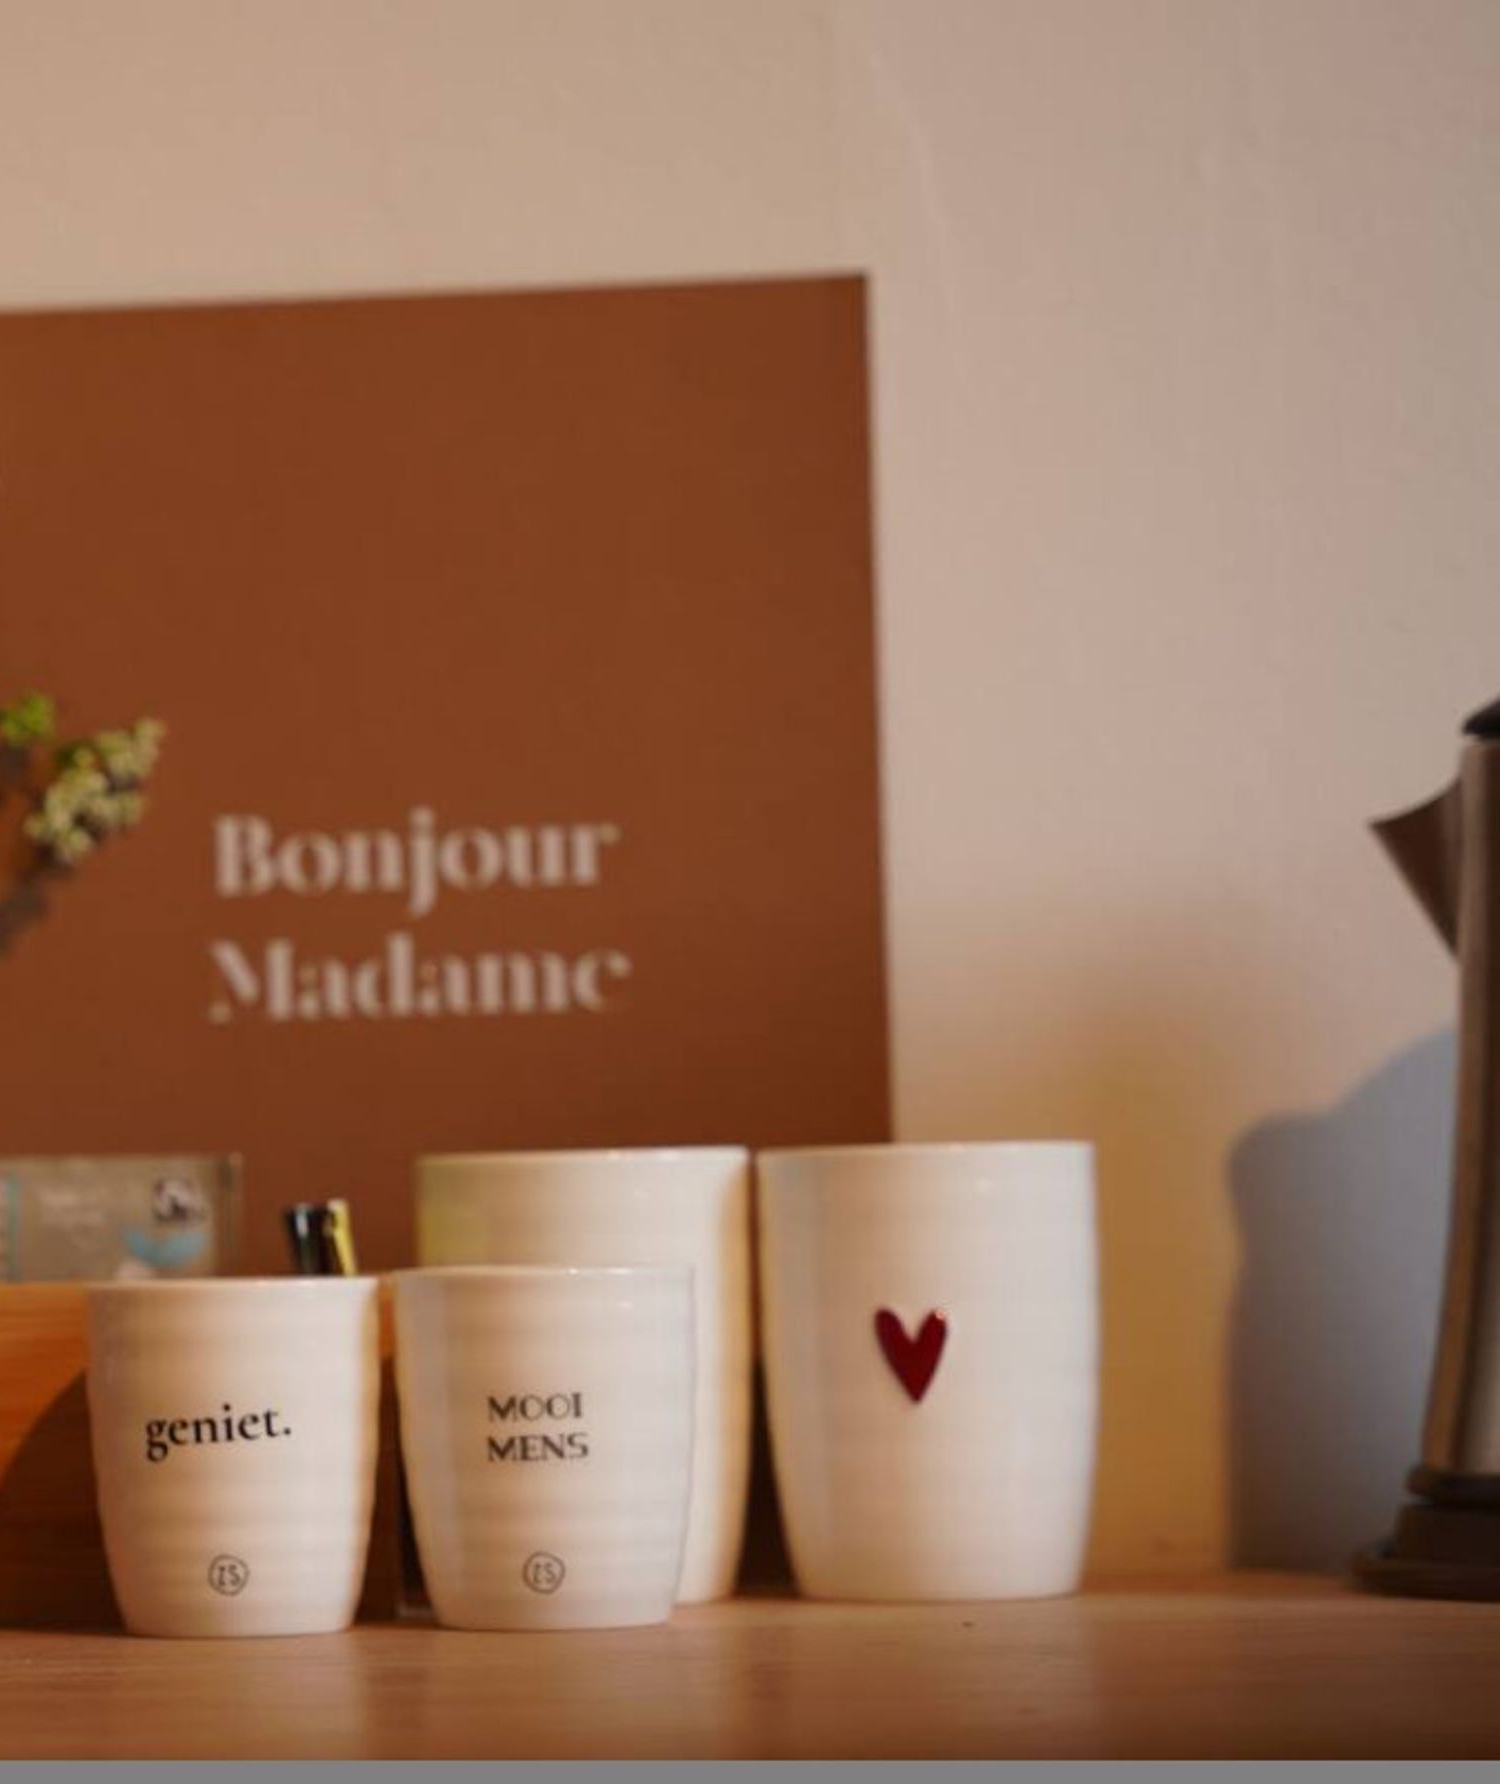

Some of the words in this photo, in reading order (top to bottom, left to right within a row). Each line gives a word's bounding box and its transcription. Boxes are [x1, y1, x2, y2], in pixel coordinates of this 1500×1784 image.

[213, 806, 620, 916] Bonjour
[208, 932, 632, 1024] Madame
[145, 1402, 293, 1463] geniet.
[486, 1392, 583, 1422] MOOI
[486, 1432, 590, 1462] MENS
